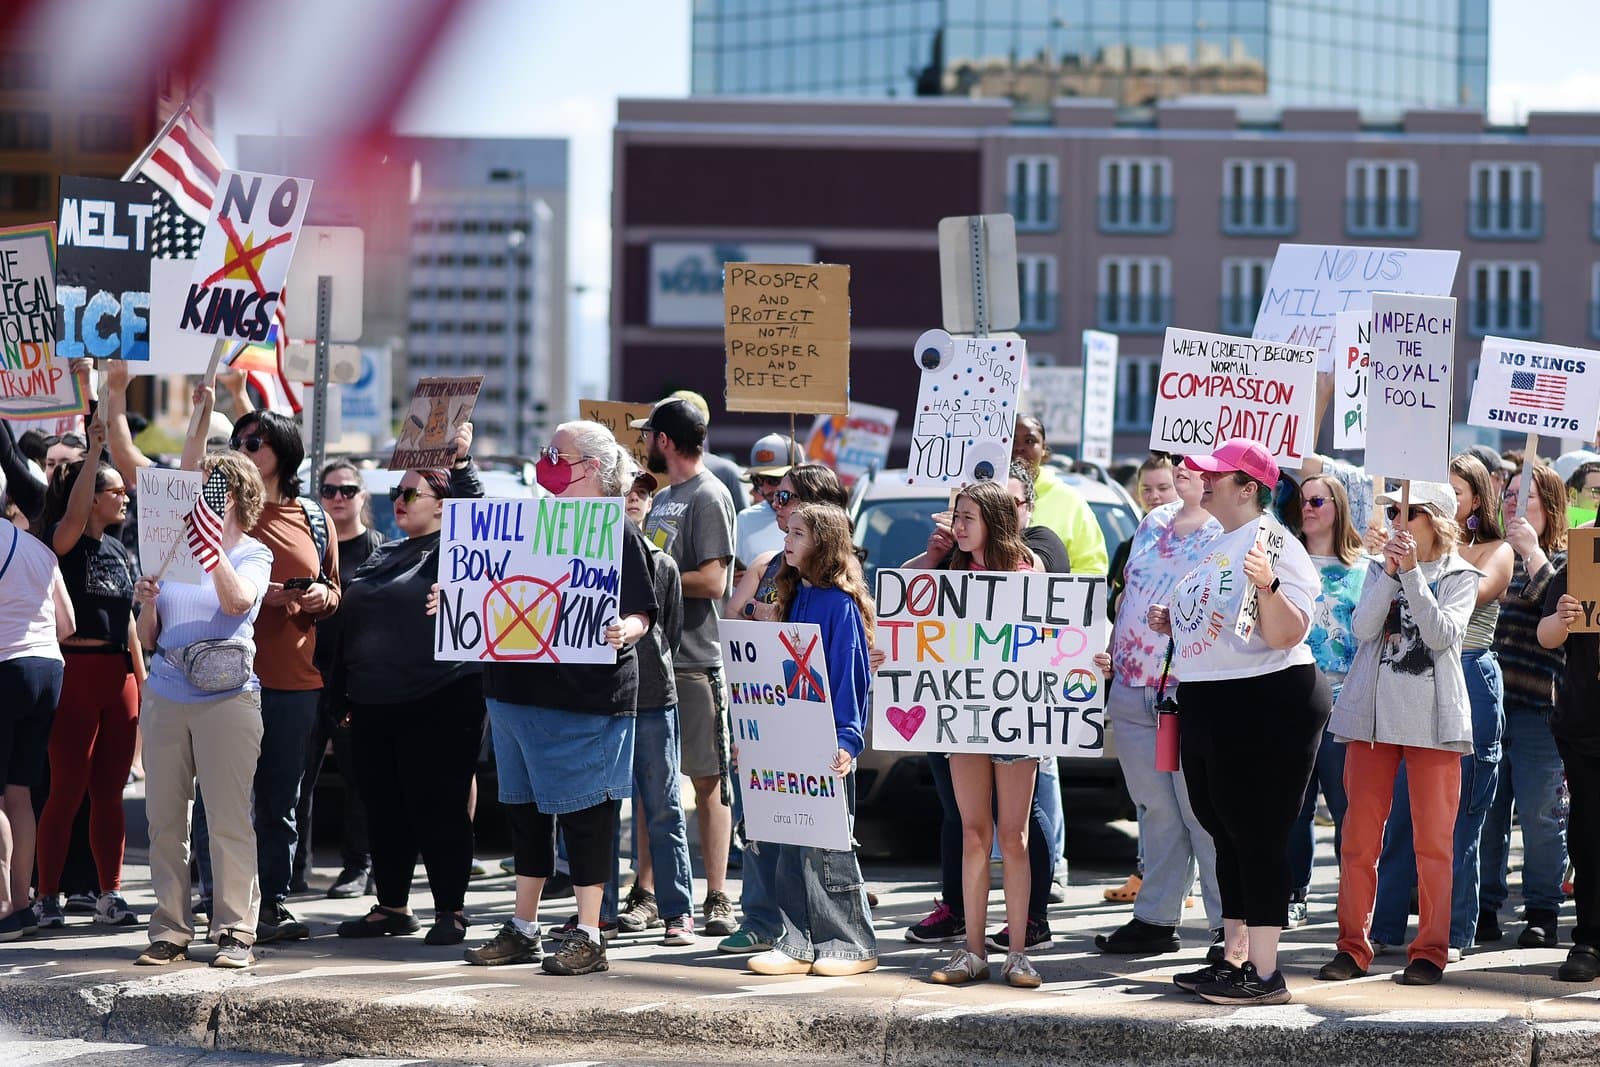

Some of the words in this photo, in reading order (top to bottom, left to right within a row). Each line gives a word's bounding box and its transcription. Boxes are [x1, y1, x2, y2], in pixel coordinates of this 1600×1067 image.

[222, 173, 299, 228] NO
[59, 198, 152, 251] MELT
[1314, 249, 1358, 281] NO
[1363, 250, 1407, 281] US
[731, 268, 820, 290] PROSPER
[758, 294, 789, 305] AND
[56, 285, 150, 361] ICE
[180, 284, 281, 342] KINGS
[730, 305, 815, 323] PROTECT
[1375, 312, 1451, 335] IMPEACH
[758, 327, 799, 339] NOT!!
[731, 340, 820, 358] PROSPER
[1172, 338, 1208, 358] WHEN
[1211, 341, 1264, 361] CRUELTY
[1263, 345, 1314, 363] BECOMES
[1397, 340, 1422, 357] THE
[768, 360, 797, 371] AND
[966, 340, 1018, 394] HISTORY
[1370, 361, 1447, 382] "ROYAL"
[1500, 351, 1526, 366] NO
[1530, 355, 1586, 374] KINGS
[734, 368, 812, 388] REJECT
[1160, 372, 1294, 405] COMPASSION
[933, 399, 960, 411] HAS
[970, 399, 997, 412] ITS
[1385, 388, 1436, 408] FOOL
[918, 412, 982, 437] EYES
[988, 408, 1015, 438] ON
[1161, 416, 1214, 446] LOOKS
[1213, 405, 1301, 459] RADICAL
[1488, 409, 1538, 425] SINCE
[1540, 415, 1579, 431] 1776
[913, 436, 965, 478] YOU
[142, 472, 159, 496] NO
[448, 502, 459, 542] I
[471, 502, 524, 542] WILL
[532, 498, 620, 561] NEVER
[448, 544, 511, 583] BOW
[568, 558, 619, 596] DOWN
[876, 570, 1007, 621] DON'T
[1021, 576, 1106, 627] LET
[729, 640, 757, 663] NO
[877, 620, 1040, 664] TRUMP
[731, 682, 786, 706] KINGS
[877, 668, 985, 702] TAKE
[992, 669, 1059, 705] OUR
[738, 718, 760, 741] IN
[936, 704, 1104, 750] RIGHTS
[750, 768, 835, 798] AMERICA!
[773, 811, 791, 824] circa
[794, 813, 815, 826] 1776
